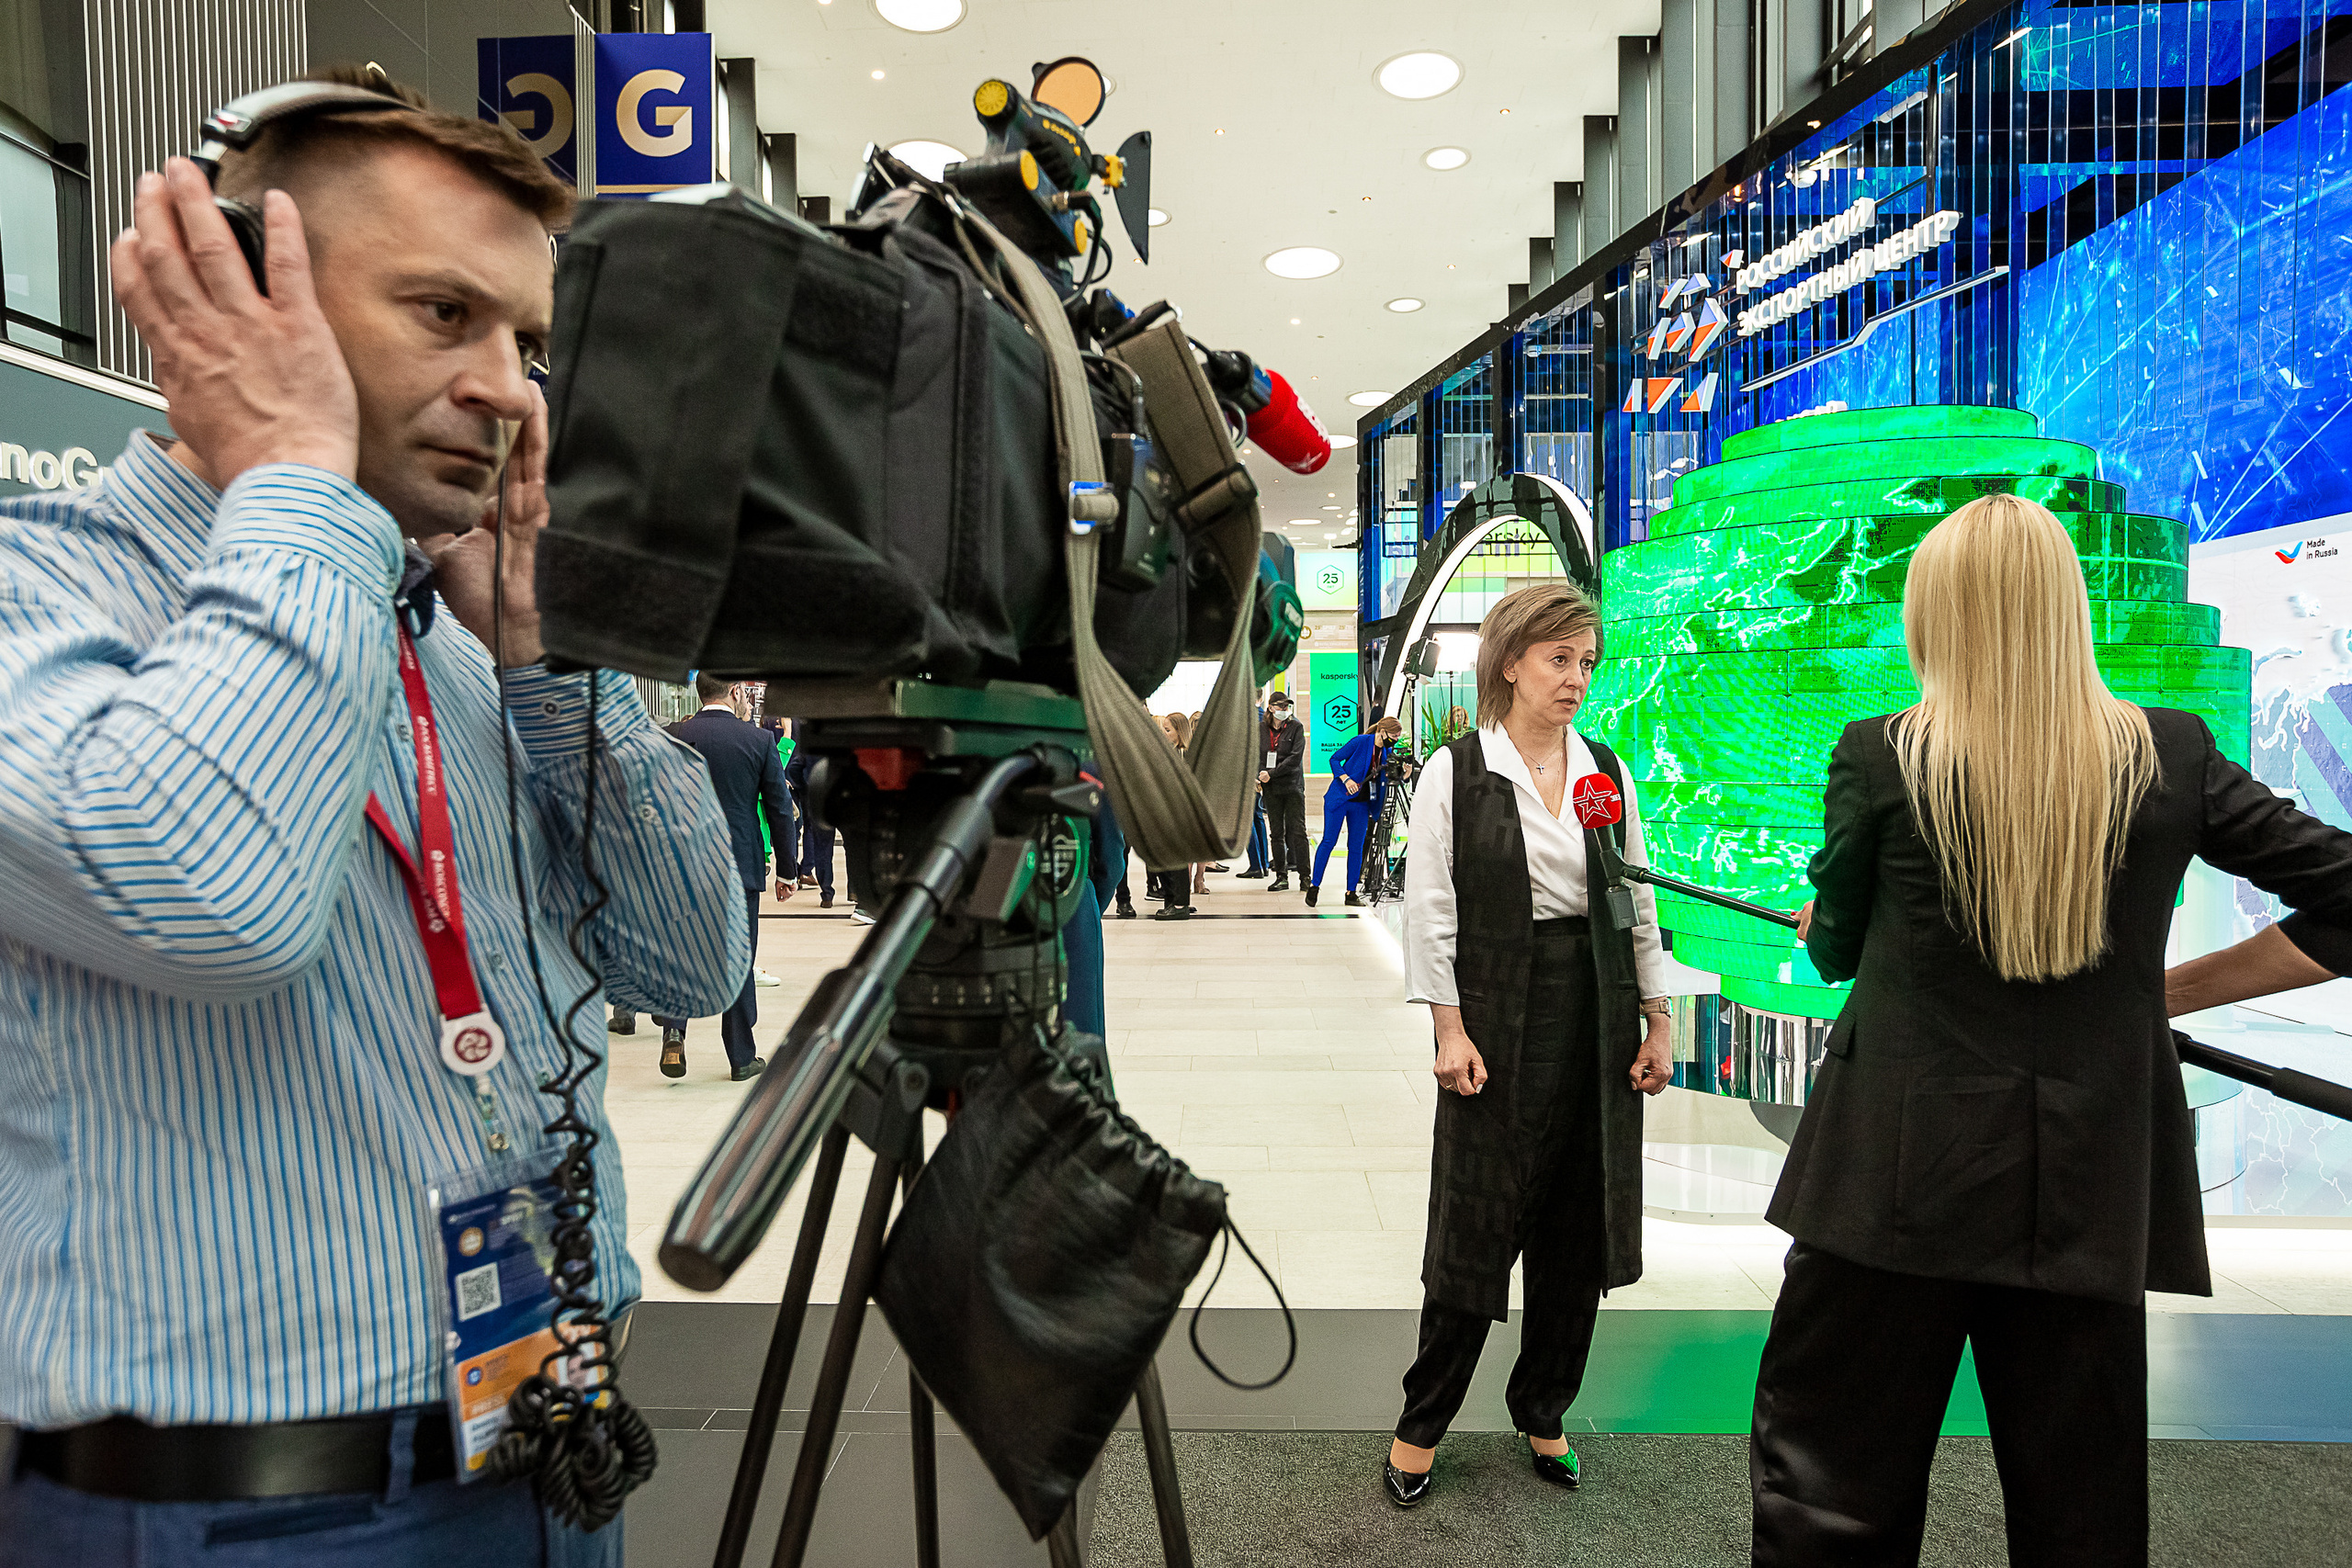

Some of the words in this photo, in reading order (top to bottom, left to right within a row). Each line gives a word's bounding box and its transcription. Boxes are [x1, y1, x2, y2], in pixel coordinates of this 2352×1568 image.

[616, 69, 693, 157] G
[1736, 197, 1875, 294] РОССИЙСКИЙ
[1737, 249, 1875, 336] ЭКСПОРТНЫЙ
[1874, 210, 1960, 271] ЦЕНТР
[0, 442, 109, 491] noG
[2307, 538, 2325, 548] Made
[2307, 551, 2313, 559] in
[2314, 547, 2338, 558] Russia
[1322, 573, 1339, 584] 25
[1331, 705, 1351, 718] 25
